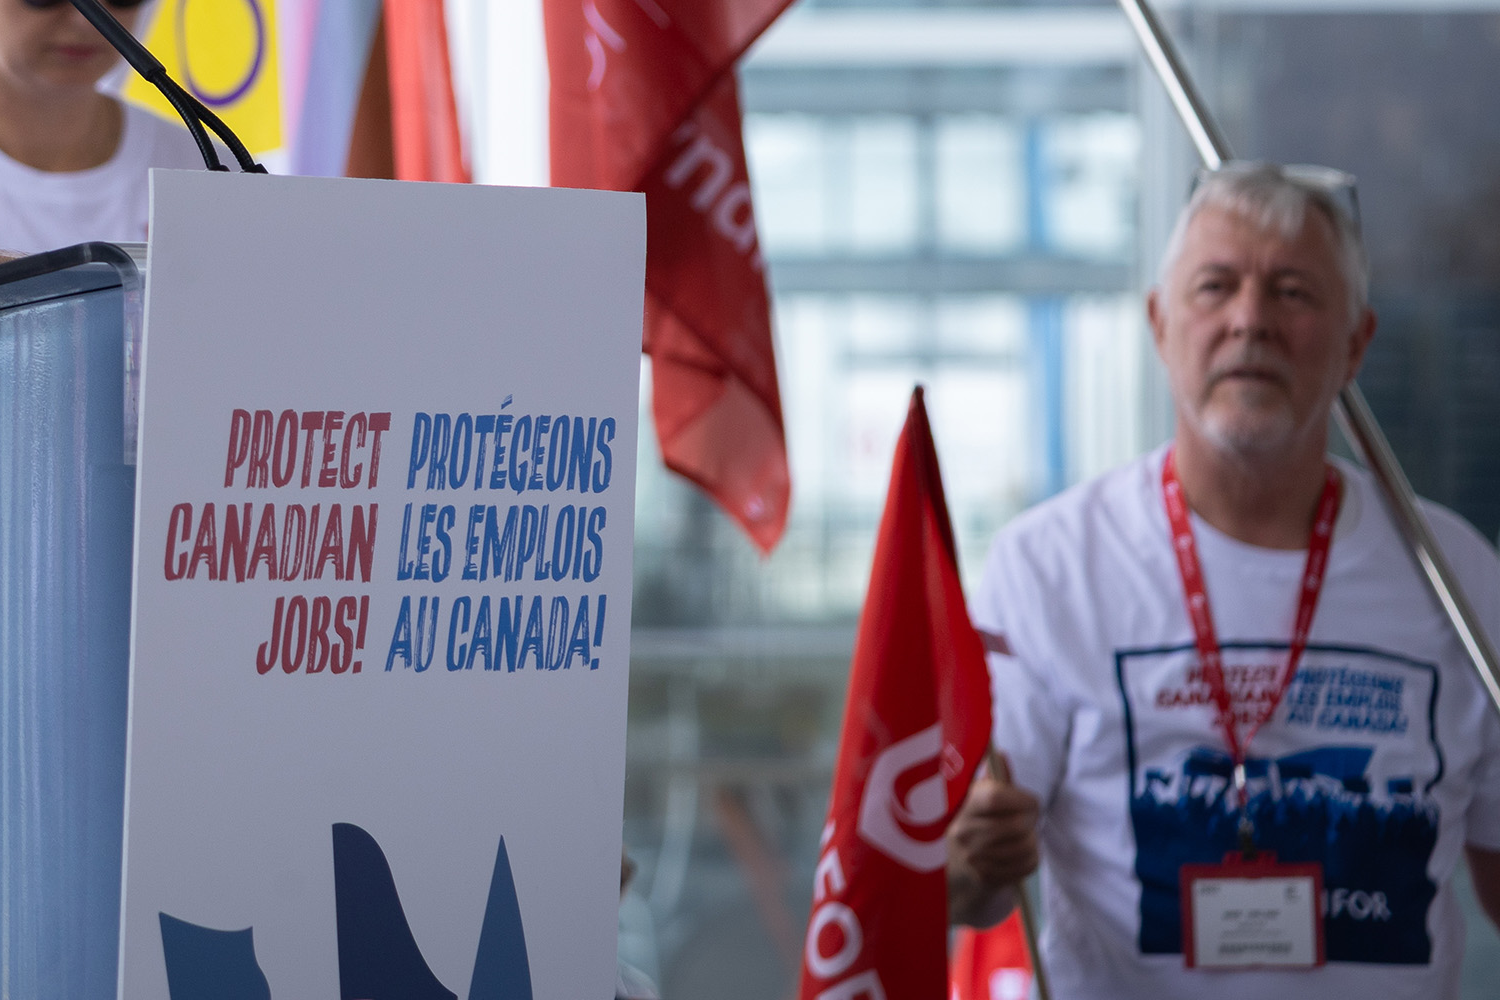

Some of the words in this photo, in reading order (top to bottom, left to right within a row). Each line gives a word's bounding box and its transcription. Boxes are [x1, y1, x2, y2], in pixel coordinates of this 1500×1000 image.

[223, 408, 392, 489] PROTECT
[406, 393, 617, 496] PROTÉGEONS
[164, 502, 379, 583] CANADIAN
[397, 502, 457, 583] LES
[461, 502, 608, 583] EMPLOIS
[256, 594, 370, 675] JOBS!
[384, 595, 440, 674] AU
[446, 594, 607, 673] CANADA!
